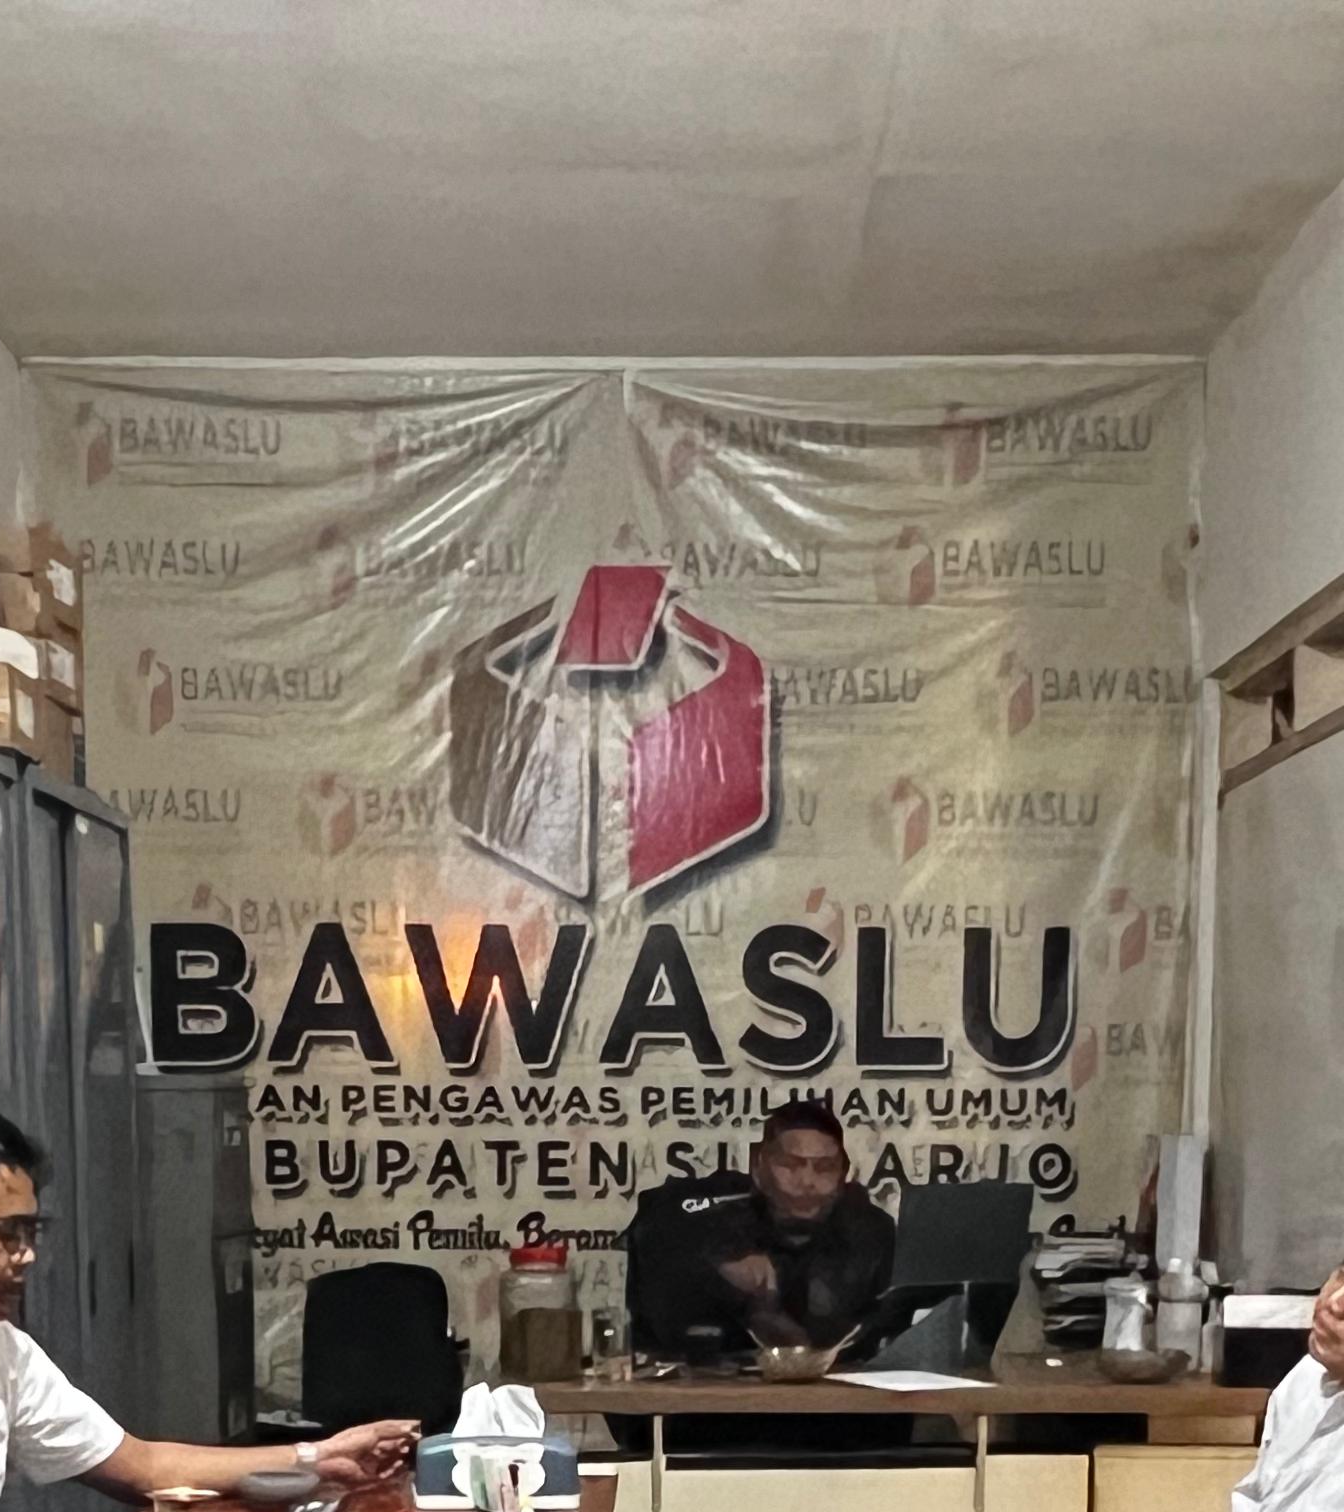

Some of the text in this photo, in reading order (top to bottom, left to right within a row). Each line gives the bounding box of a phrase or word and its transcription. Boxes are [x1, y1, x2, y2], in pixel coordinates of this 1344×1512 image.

[118, 417, 282, 455] BAWASLU
[987, 414, 1153, 452] BAWASLU
[941, 539, 1106, 576] BAWASLU
[181, 666, 344, 701] BAWASLU
[937, 790, 1101, 828] BAWASLU
[149, 921, 1076, 1070] BAWASLU
[256, 1084, 322, 1114] AN
[342, 1084, 621, 1115] PENGAWAS
[926, 1087, 1070, 1118] UMUM
[264, 1139, 629, 1187] BUPATEN
